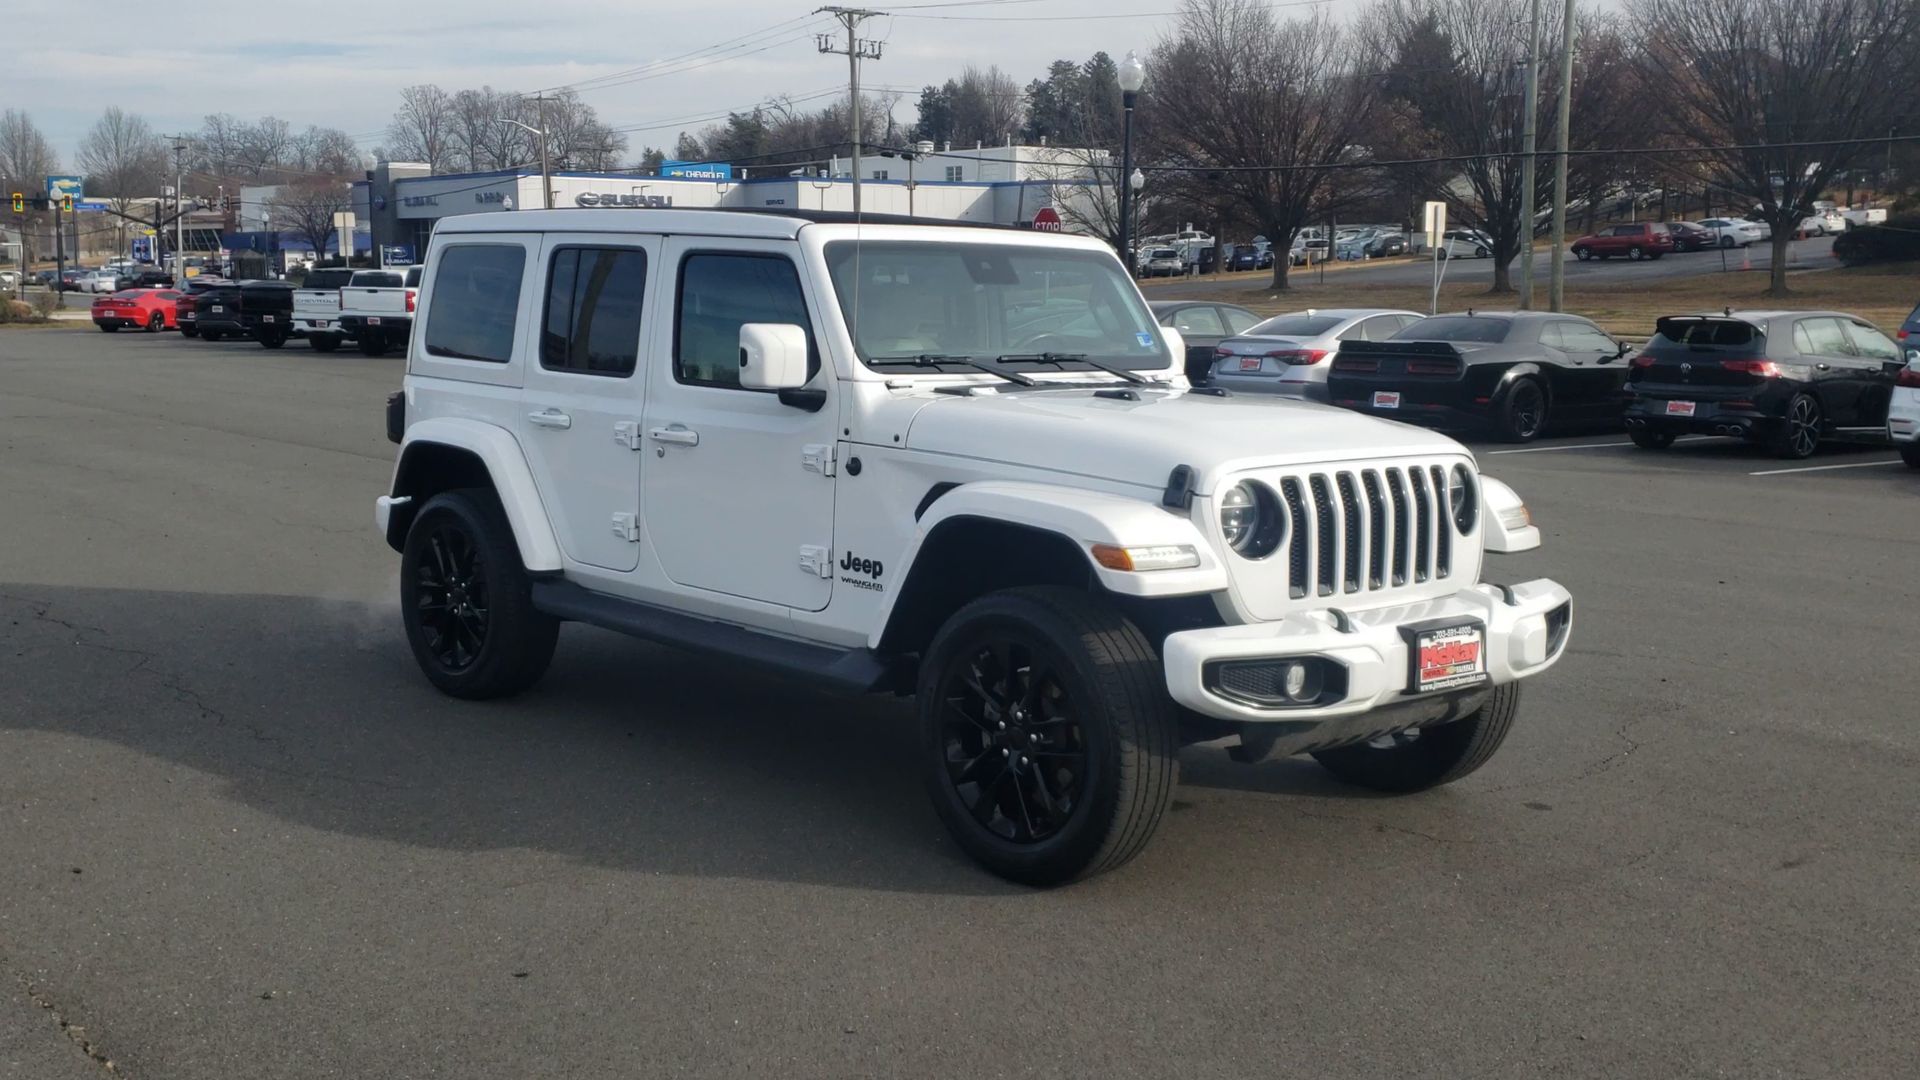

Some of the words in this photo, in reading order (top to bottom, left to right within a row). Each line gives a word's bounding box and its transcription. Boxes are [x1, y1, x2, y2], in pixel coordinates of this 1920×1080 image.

[685, 170, 725, 179] CHEVROLET
[600, 194, 672, 208] SUBARU
[1035, 222, 1060, 231] STOP
[840, 551, 883, 579] Jeep
[1420, 641, 1479, 668] McKay
